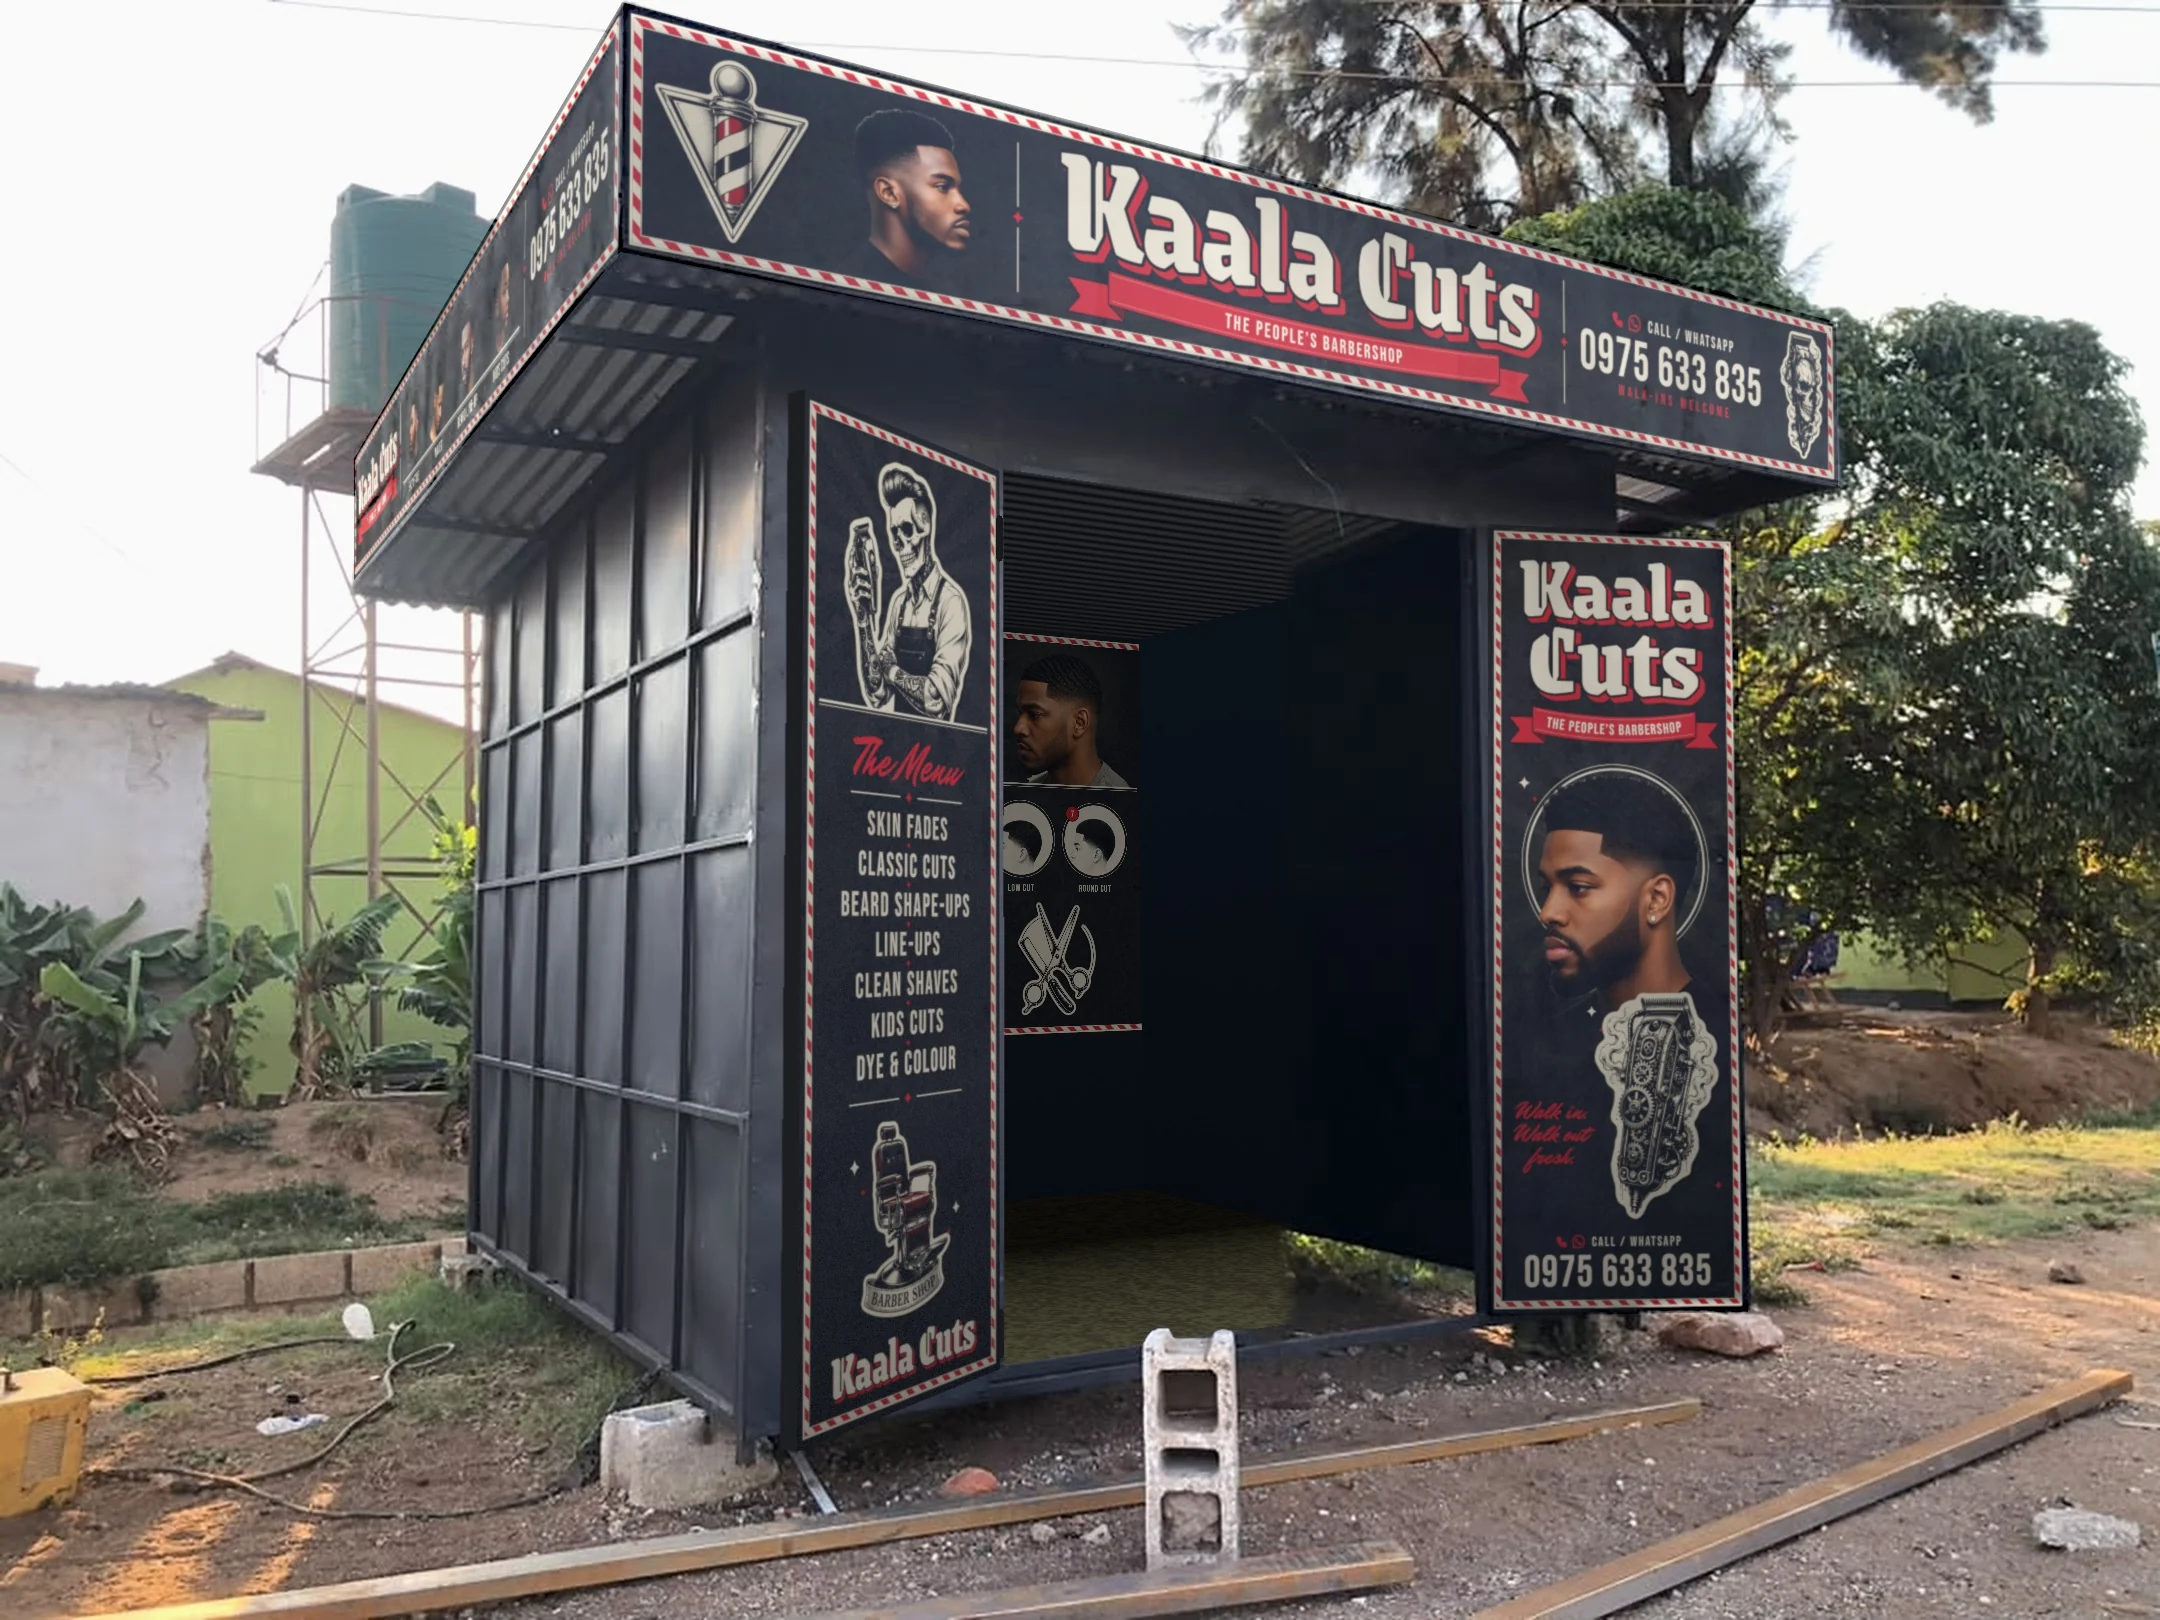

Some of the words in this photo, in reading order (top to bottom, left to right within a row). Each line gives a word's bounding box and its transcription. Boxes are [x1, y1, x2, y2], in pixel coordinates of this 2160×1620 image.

[530, 205, 556, 281] 0975
[559, 169, 581, 240] 633
[584, 126, 609, 204] 835
[1060, 152, 1345, 314] Kaala
[1358, 231, 1543, 358] Cuts
[1225, 312, 1251, 334] THE
[1255, 321, 1318, 349] PEOPLE'S
[1322, 335, 1403, 364] BARBERSHOP
[1647, 320, 1672, 339] CALL
[1675, 328, 1681, 341] /
[1685, 329, 1735, 353] WHATSAPP
[1580, 328, 1649, 382] 0975
[1658, 346, 1706, 395] 633
[1715, 359, 1762, 407] 835
[1618, 384, 1673, 407] WALK-INS
[1680, 397, 1730, 419] WELCOME
[1519, 559, 1714, 630] Kaala
[1529, 626, 1706, 706] Cuts
[1546, 716, 1566, 731] THE
[1568, 719, 1615, 736] PEOPLE'S
[1618, 721, 1683, 736] BARBERSHOP
[852, 736, 896, 778] The
[894, 742, 965, 787] Menu
[867, 809, 901, 839] SKIN
[907, 813, 948, 842] FADES
[858, 849, 918, 878] CLASSIC
[922, 854, 956, 880] CUTS
[841, 890, 889, 917] BEARD
[894, 891, 970, 918] SHAPE-UPS
[1022, 883, 1035, 892] CUT
[1078, 884, 1099, 893] ROUND
[875, 931, 941, 957] LINE-UPS
[855, 971, 901, 999] CLEAN
[906, 969, 958, 996] SHAVES
[871, 1011, 905, 1039] KIDS
[909, 1008, 944, 1036] CUTS
[856, 1052, 884, 1082] DYE
[889, 1051, 899, 1077] &
[904, 1045, 957, 1075] COLOUR
[1514, 1101, 1563, 1120] Walk
[1565, 1105, 1587, 1120] in.
[1513, 1123, 1559, 1143] Walk
[1563, 1126, 1596, 1143] out
[1522, 1147, 1575, 1174] fresh.
[1591, 1236, 1616, 1247] CALL
[1629, 1235, 1682, 1247] WHATSAPP
[1524, 1254, 1593, 1288] 0975
[1602, 1253, 1652, 1287] 633
[1661, 1253, 1711, 1286] 835
[871, 1288, 911, 1309] BARBER
[912, 1274, 938, 1303] SHOP
[831, 1336, 917, 1404] Kaala
[919, 1319, 978, 1369] Cuts
